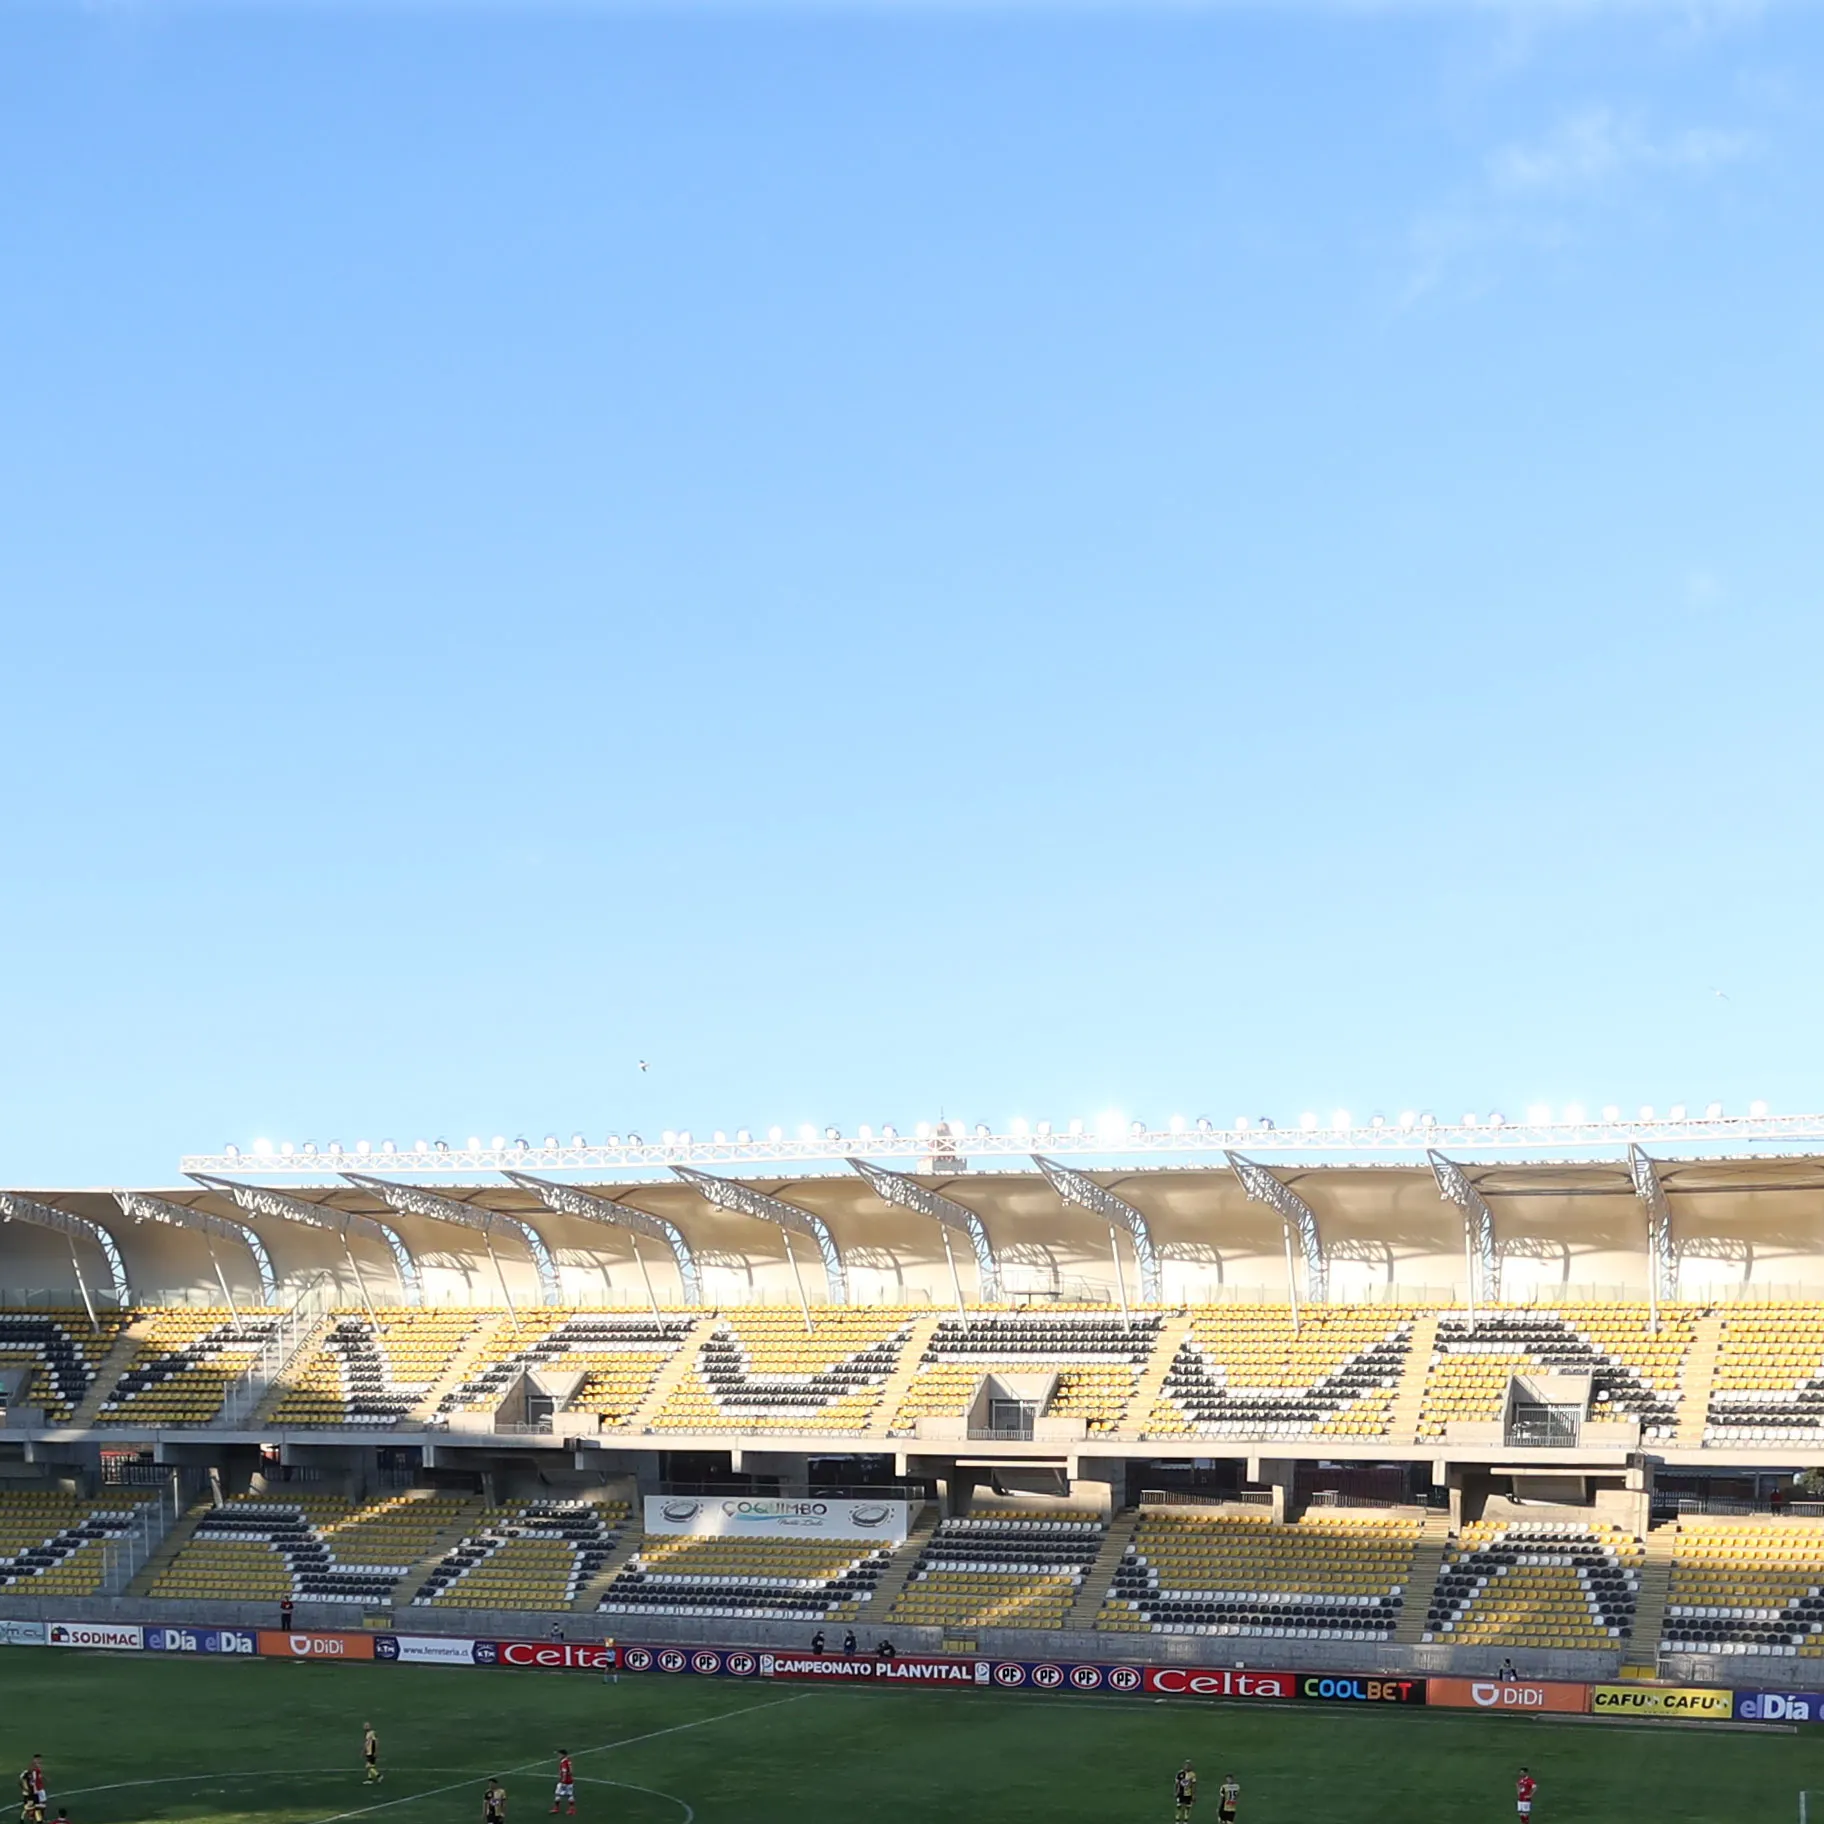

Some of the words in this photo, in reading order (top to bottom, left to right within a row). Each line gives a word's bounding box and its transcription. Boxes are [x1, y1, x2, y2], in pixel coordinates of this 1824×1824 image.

[72, 1631, 138, 1646] SODIMAC
[149, 1629, 197, 1651] elDía
[205, 1632, 253, 1653] elDía
[313, 1640, 344, 1654] DiDi
[632, 1654, 645, 1665] PF
[665, 1655, 678, 1667] PF
[699, 1657, 713, 1669] PF
[733, 1657, 748, 1670] PF
[775, 1659, 872, 1676] CAMPEONATO
[876, 1662, 972, 1680] PLANVITAL
[1002, 1668, 1017, 1681] PF
[1039, 1669, 1055, 1683] PF
[1078, 1670, 1094, 1684] PF
[1116, 1672, 1132, 1686] PF
[1153, 1669, 1281, 1697] Celta
[1304, 1678, 1412, 1701] COOLBET
[1504, 1688, 1544, 1706] DiDi
[1595, 1692, 1645, 1707] CAFU
[1663, 1695, 1719, 1709] CAFU
[1740, 1694, 1809, 1720] elDía
